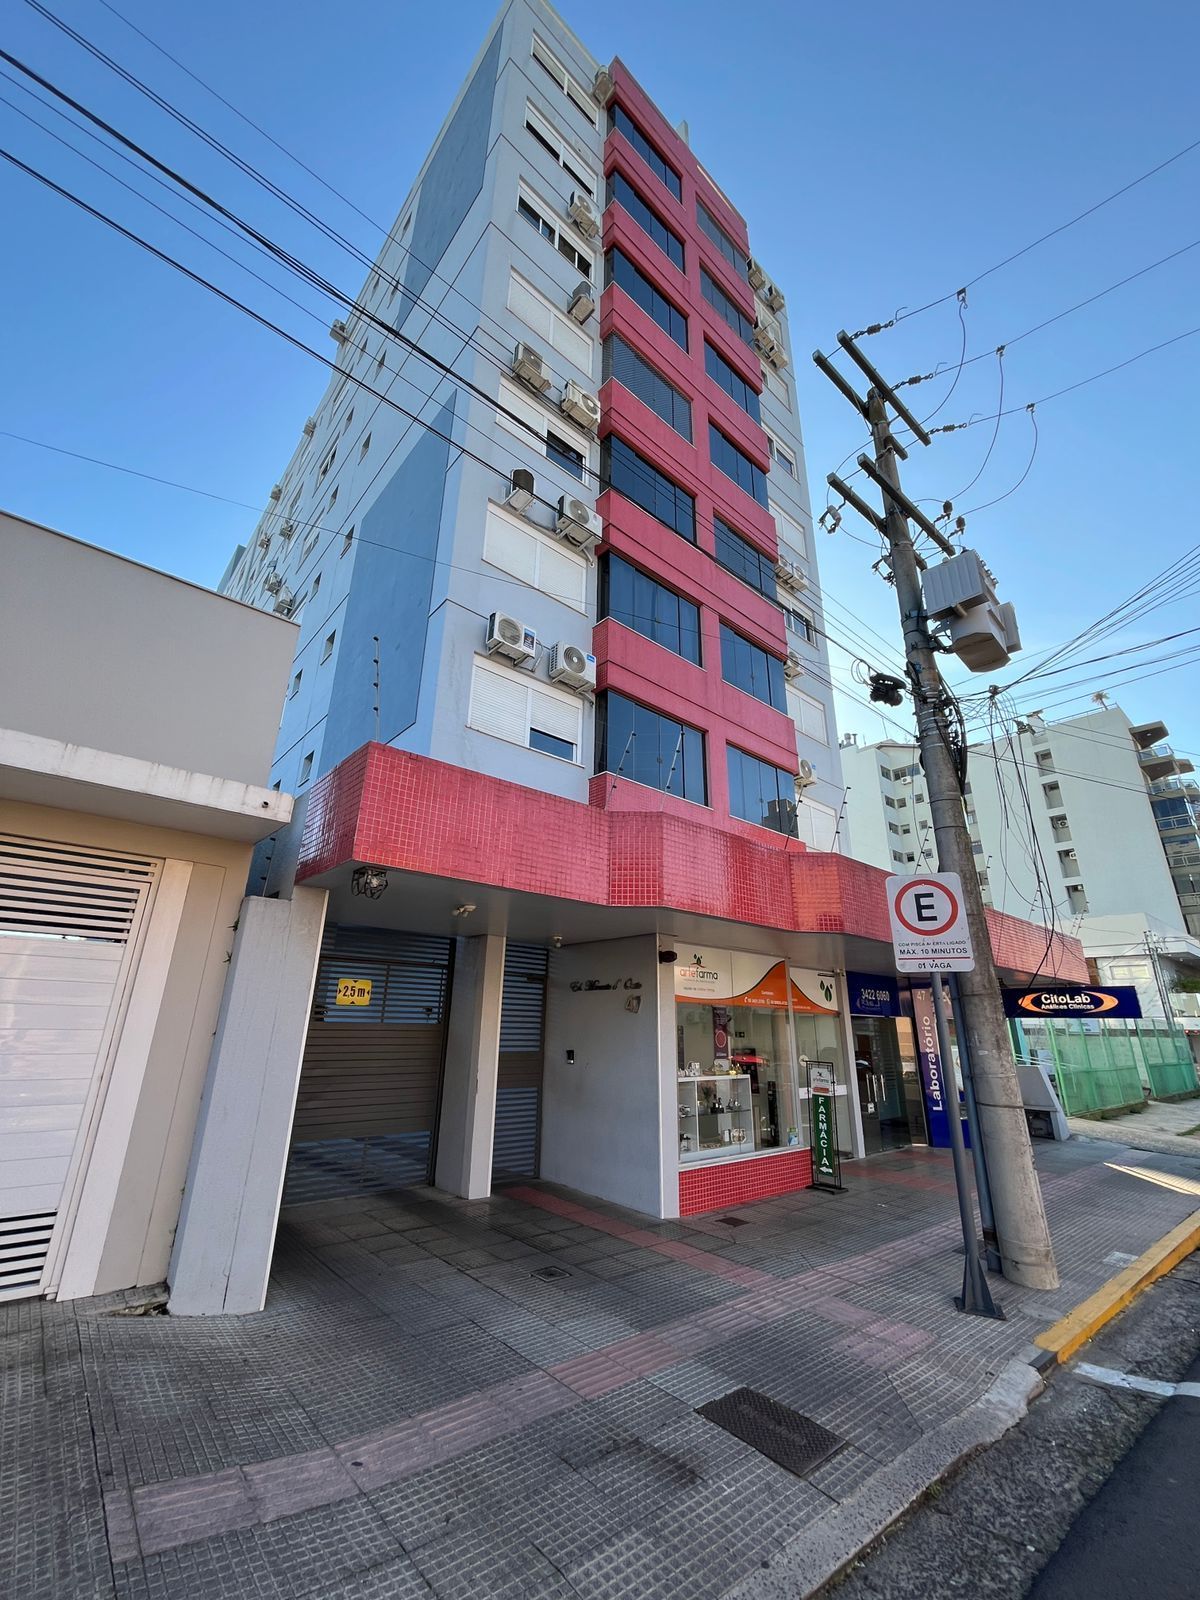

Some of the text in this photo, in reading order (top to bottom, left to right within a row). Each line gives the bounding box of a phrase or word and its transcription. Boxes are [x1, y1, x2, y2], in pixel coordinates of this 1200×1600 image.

[914, 892, 938, 922] E
[342, 985, 365, 998] 2,5 m
[861, 988, 876, 1000] 3422
[916, 990, 926, 1001] 47
[1041, 993, 1091, 1004] CitoLab
[922, 1015, 943, 1111] Laboratório
